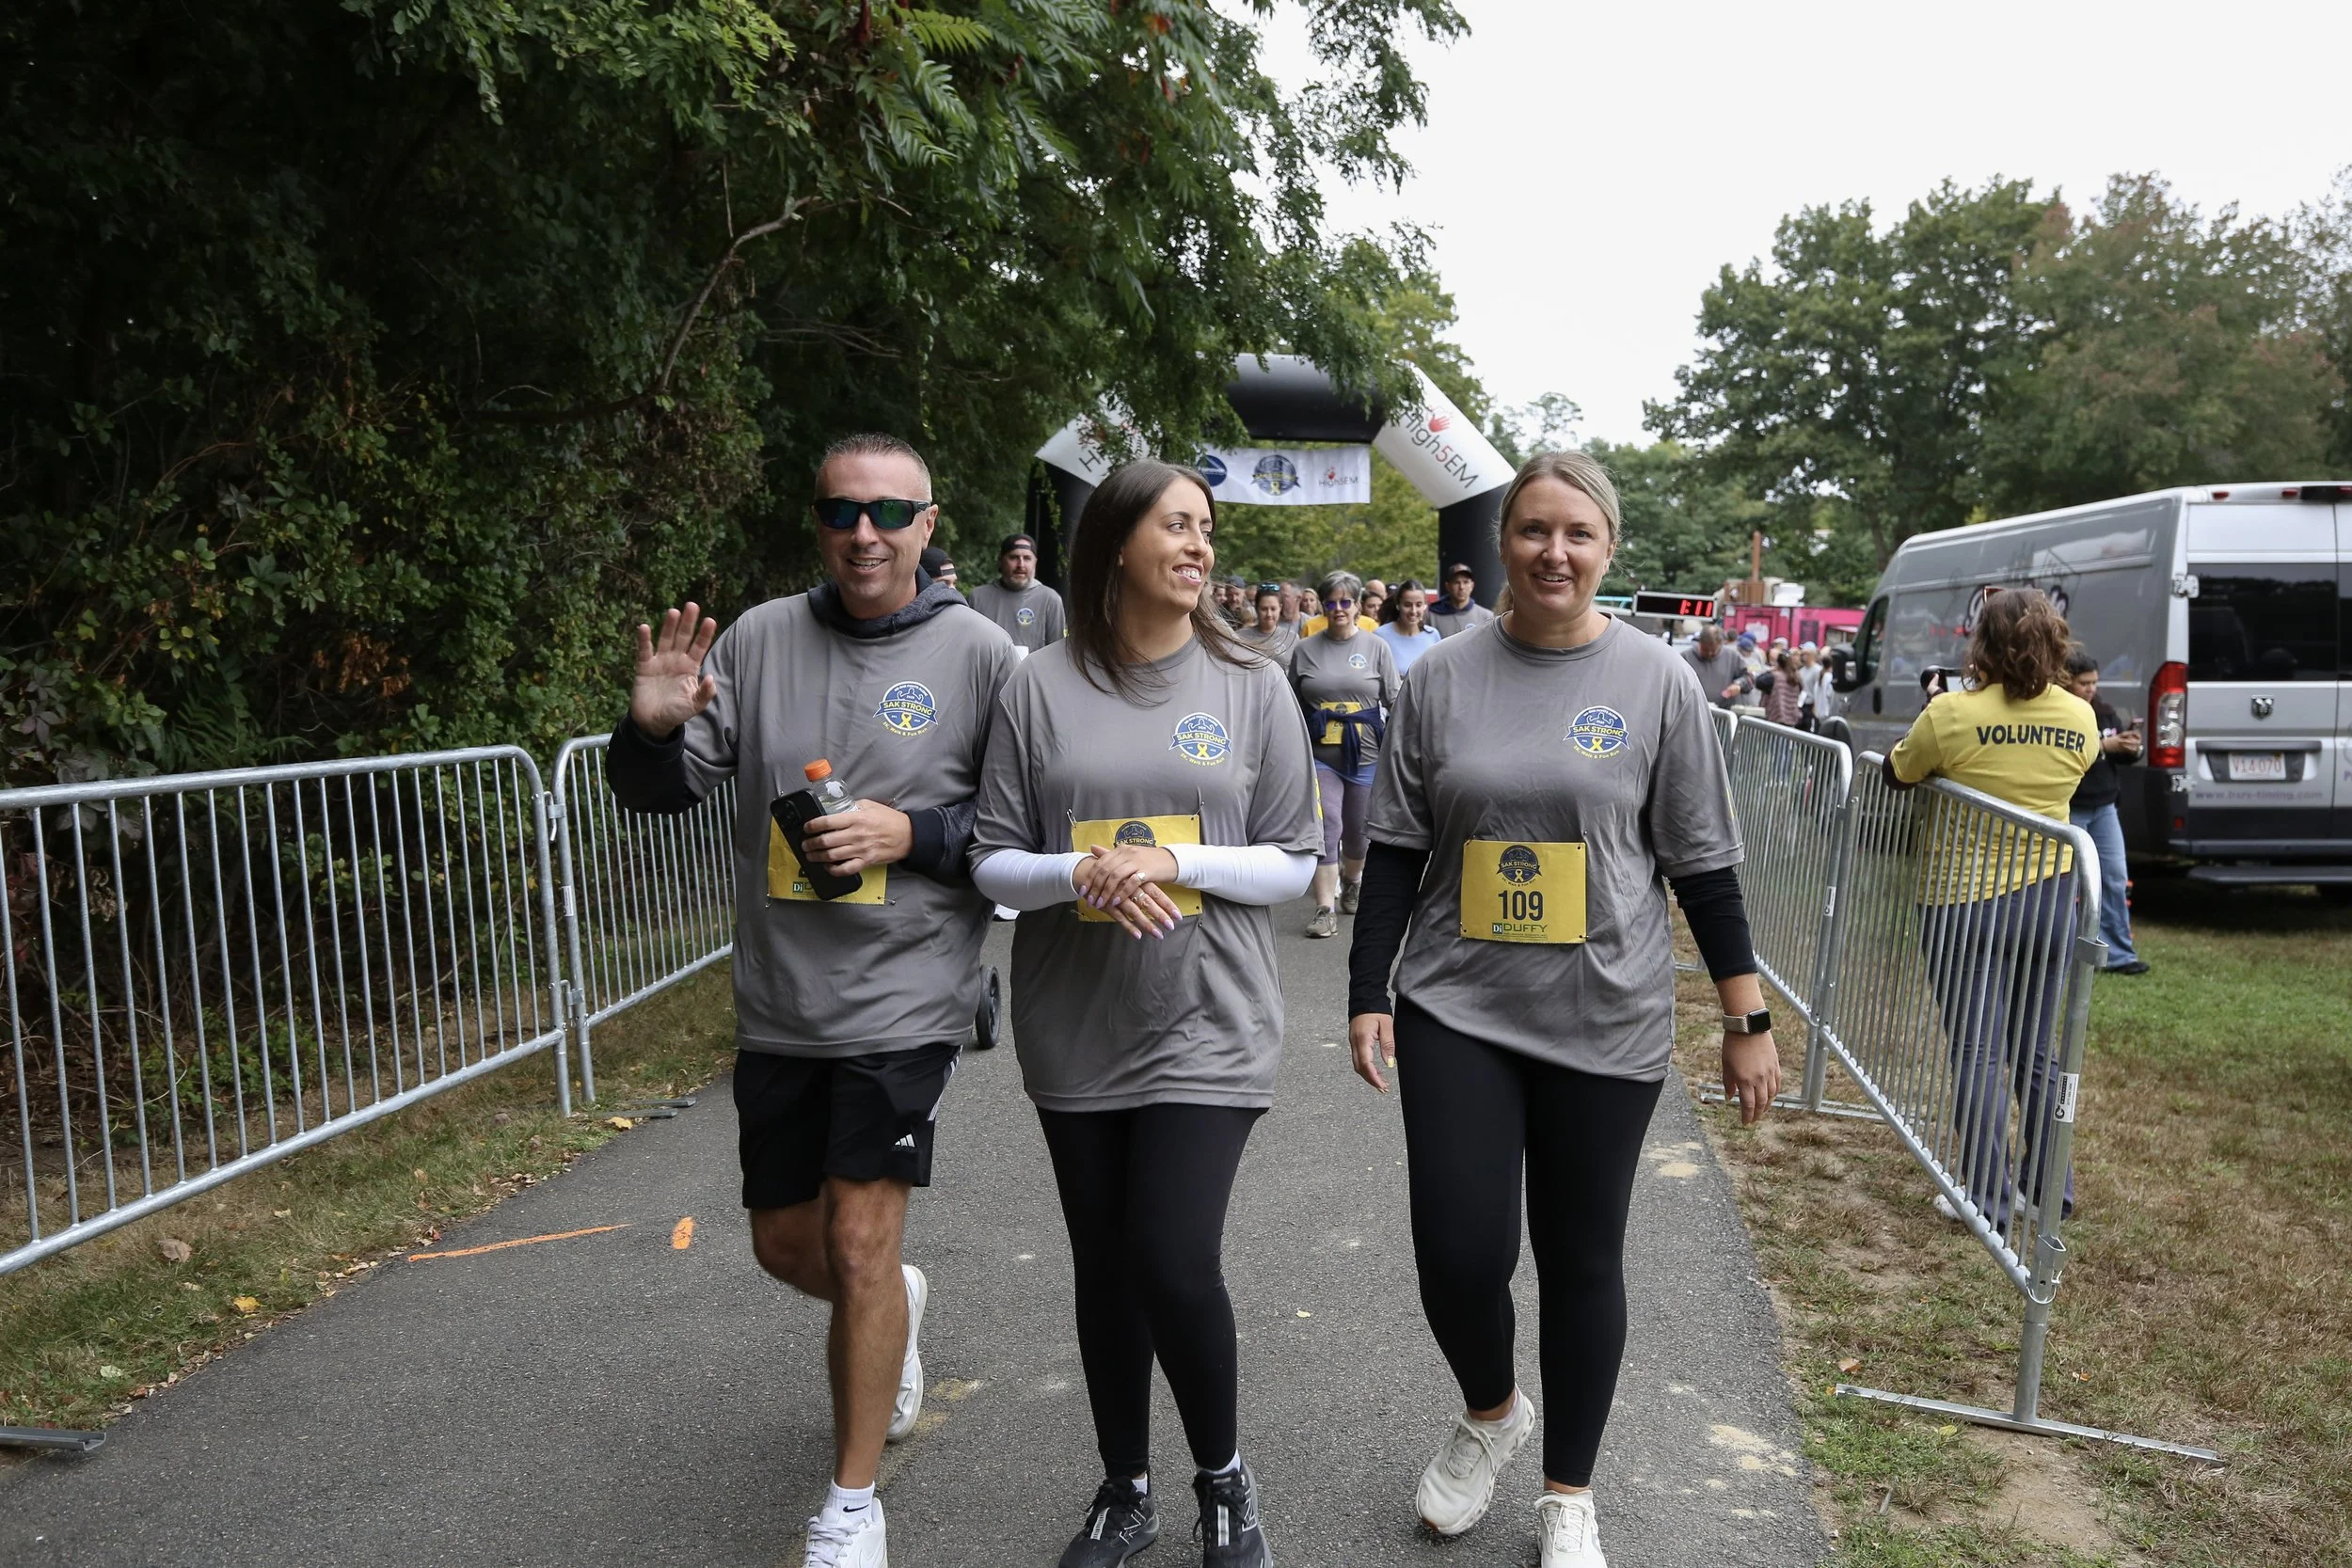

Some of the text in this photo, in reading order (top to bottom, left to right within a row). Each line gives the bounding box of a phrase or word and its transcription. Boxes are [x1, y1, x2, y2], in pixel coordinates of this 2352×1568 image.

[901, 701, 933, 716] STRONG
[1591, 726, 1624, 737] STRONG
[1176, 732, 1226, 745] SAK STRONG
[1976, 724, 2086, 752] VOLUNTEER
[1501, 861, 1537, 869] SAK STRONG
[793, 883, 803, 892] Di
[1498, 890, 1544, 921] 109
[1493, 923, 1549, 933] Di DUFFY
